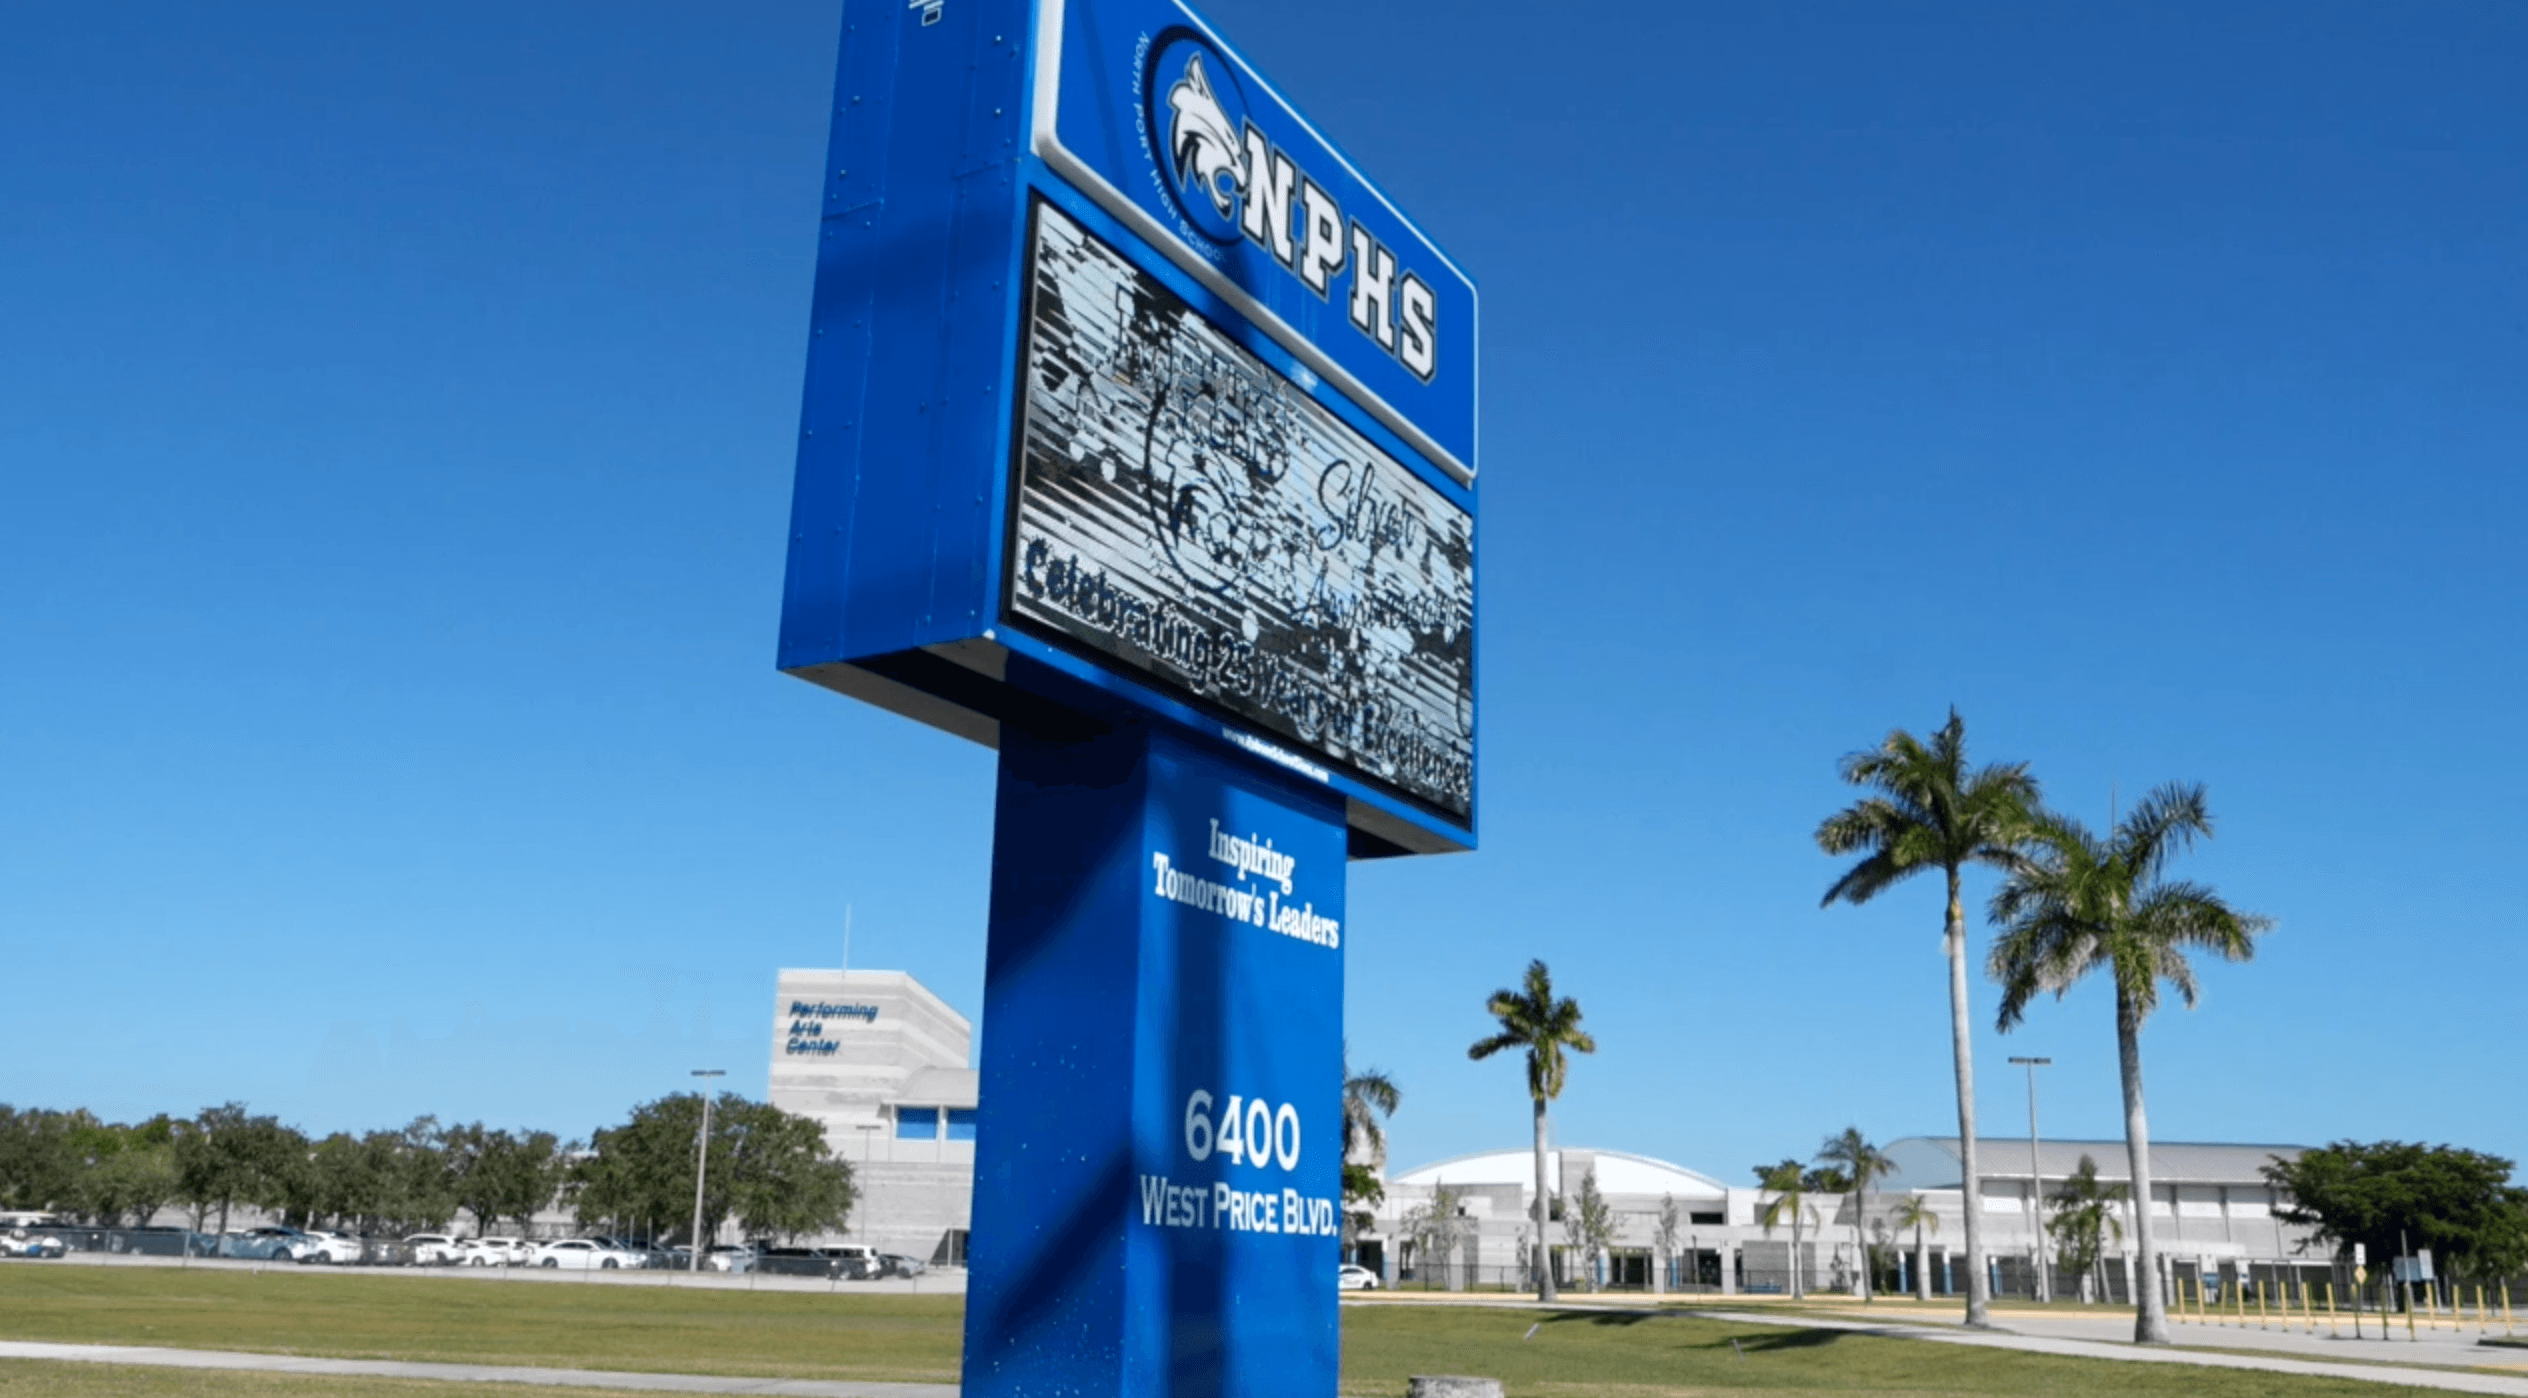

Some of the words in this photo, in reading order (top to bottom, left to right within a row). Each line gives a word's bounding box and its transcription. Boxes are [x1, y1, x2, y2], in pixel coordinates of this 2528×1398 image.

[1132, 31, 1150, 95] NORTH
[1133, 102, 1152, 161] PORT
[1150, 169, 1177, 220] HIGH
[1238, 117, 1437, 385] NPHS
[1317, 459, 1417, 550] Silver
[1026, 534, 1212, 696] Celebrating
[1217, 630, 1255, 697] 25
[1208, 817, 1295, 896] Inspiring
[1153, 851, 1265, 927] Tomorrow's
[1268, 890, 1340, 949] Leaders
[785, 1037, 840, 1056] Center
[788, 1020, 822, 1036] Arts
[789, 1001, 879, 1023] Performing
[1184, 1089, 1300, 1171] 6400
